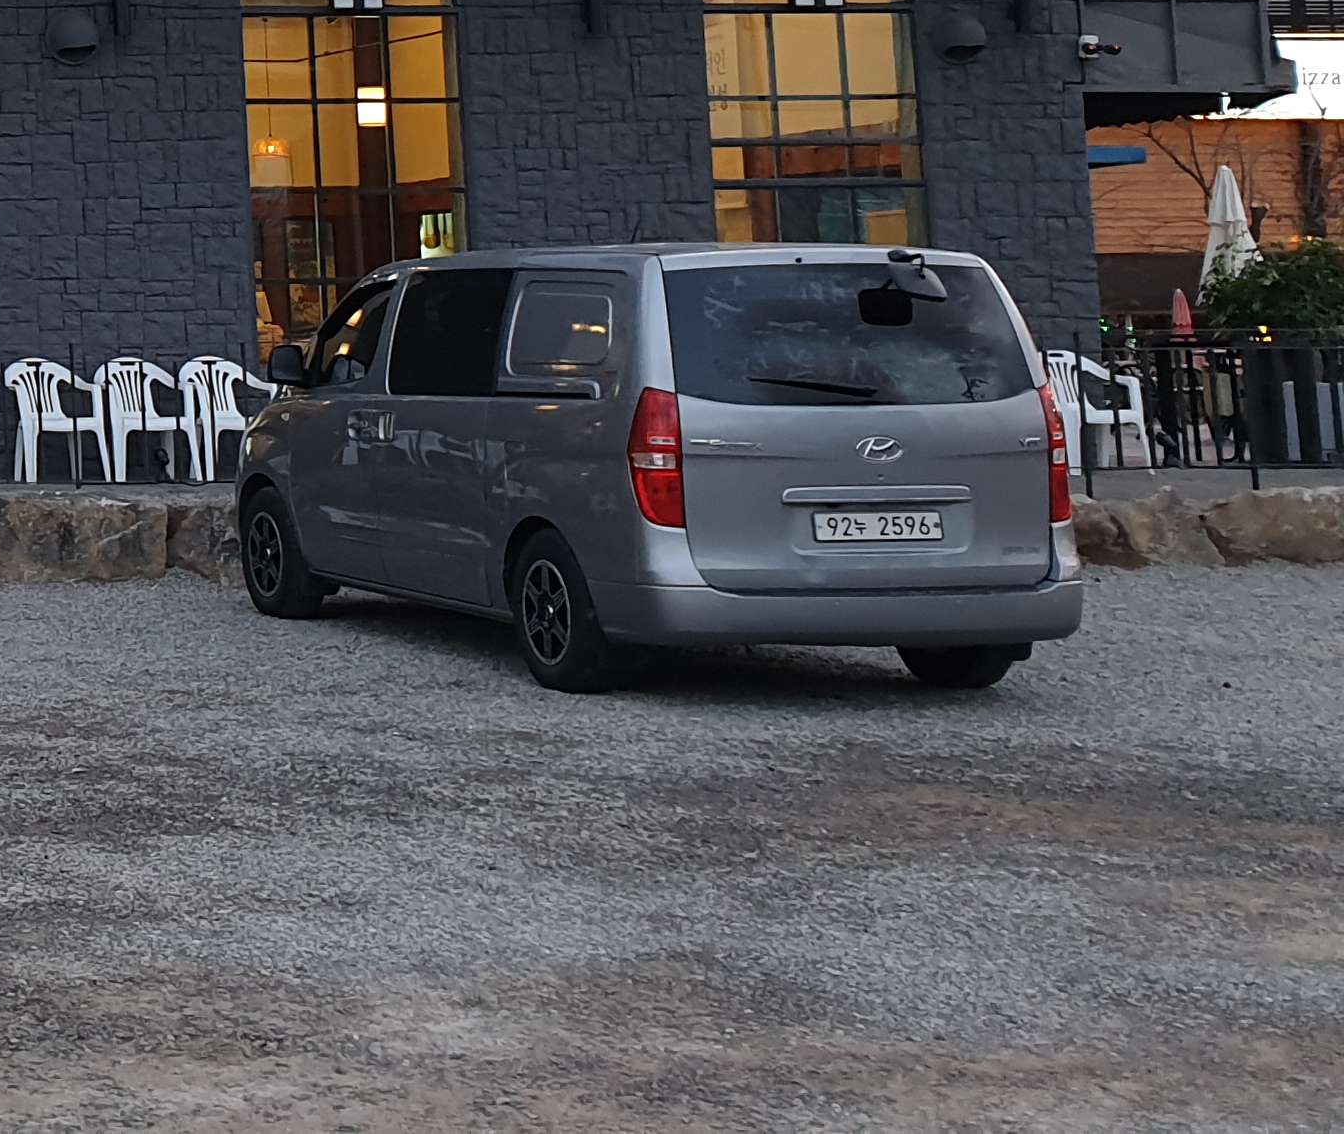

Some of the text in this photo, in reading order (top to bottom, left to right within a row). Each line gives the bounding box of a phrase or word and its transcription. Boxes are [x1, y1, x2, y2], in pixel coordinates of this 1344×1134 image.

[1301, 66, 1342, 86] izza
[826, 515, 931, 537] 92누 2596
